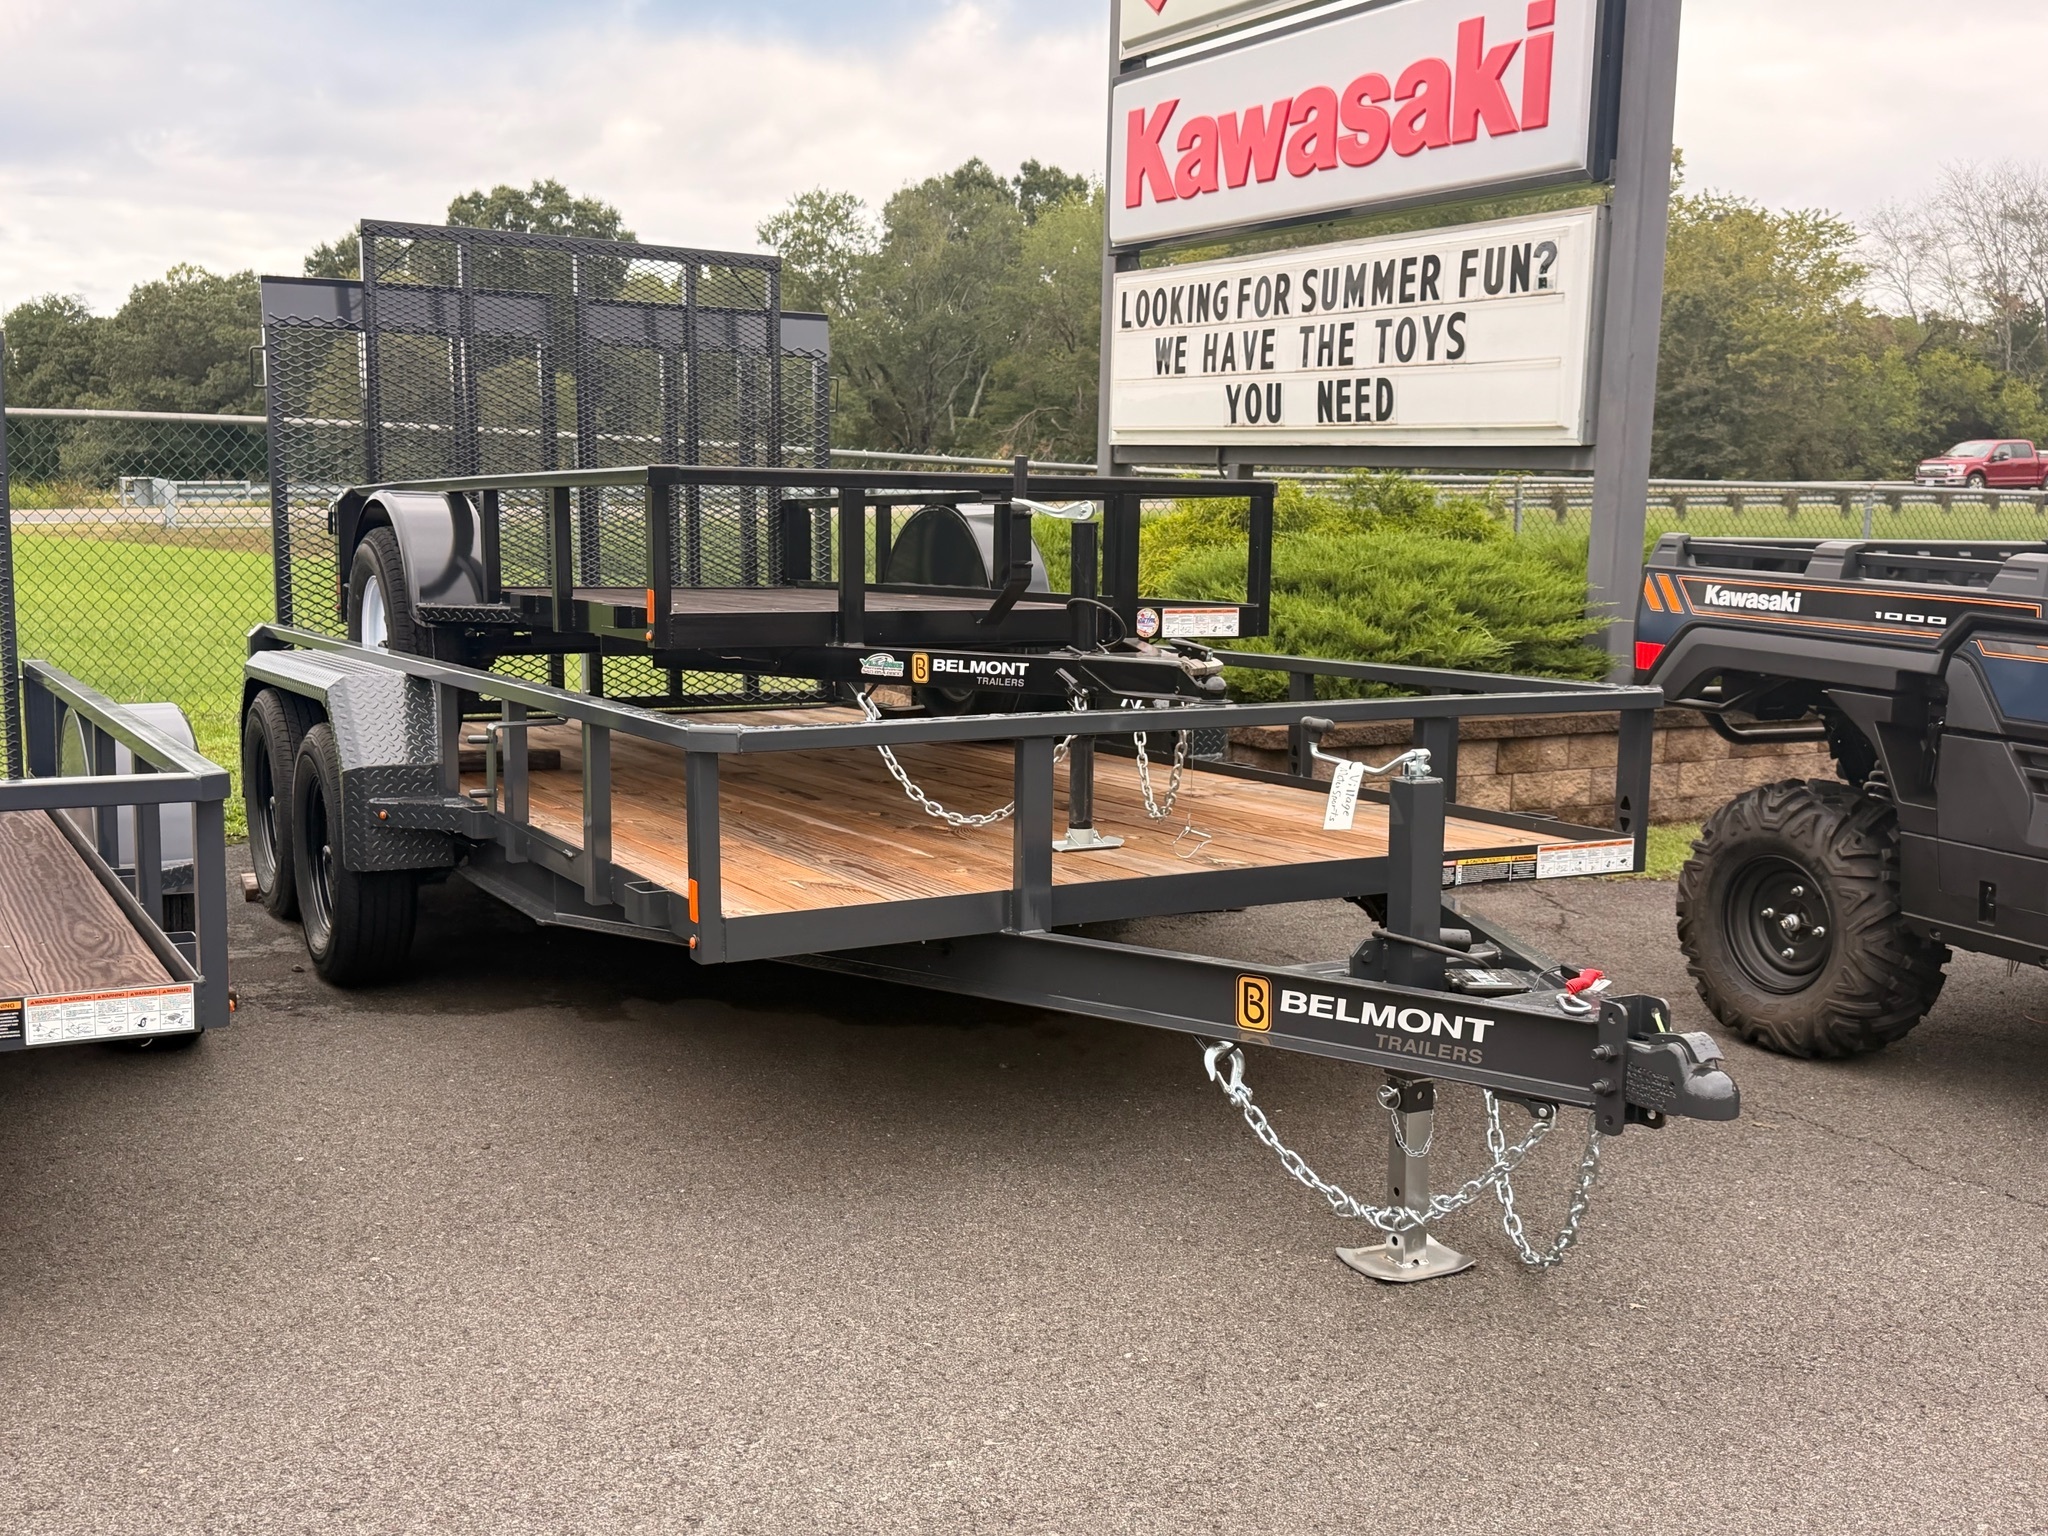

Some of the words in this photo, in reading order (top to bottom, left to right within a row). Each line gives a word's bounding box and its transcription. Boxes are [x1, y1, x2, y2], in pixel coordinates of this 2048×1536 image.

[1124, 0, 1556, 209] Kawasaki
[1121, 280, 1229, 329] LOOKING
[1237, 273, 1291, 319] FOR
[1301, 254, 1441, 313] SUMMER
[1458, 240, 1558, 298] FUN?
[1155, 335, 1187, 375] WE
[1202, 328, 1275, 373] HAVE
[1300, 321, 1355, 368] THE
[1375, 311, 1467, 363] TOYS
[1225, 383, 1282, 424] YOU
[1317, 377, 1394, 423] NEED
[1704, 584, 1802, 613] Kawasaki
[1874, 611, 1947, 625] 1000
[932, 658, 1030, 676] BELMONT
[977, 676, 1025, 687] TRAILERS
[1341, 774, 1360, 817] Village
[1280, 989, 1495, 1043] BELMONT
[1375, 1033, 1484, 1064] TRAILERS
